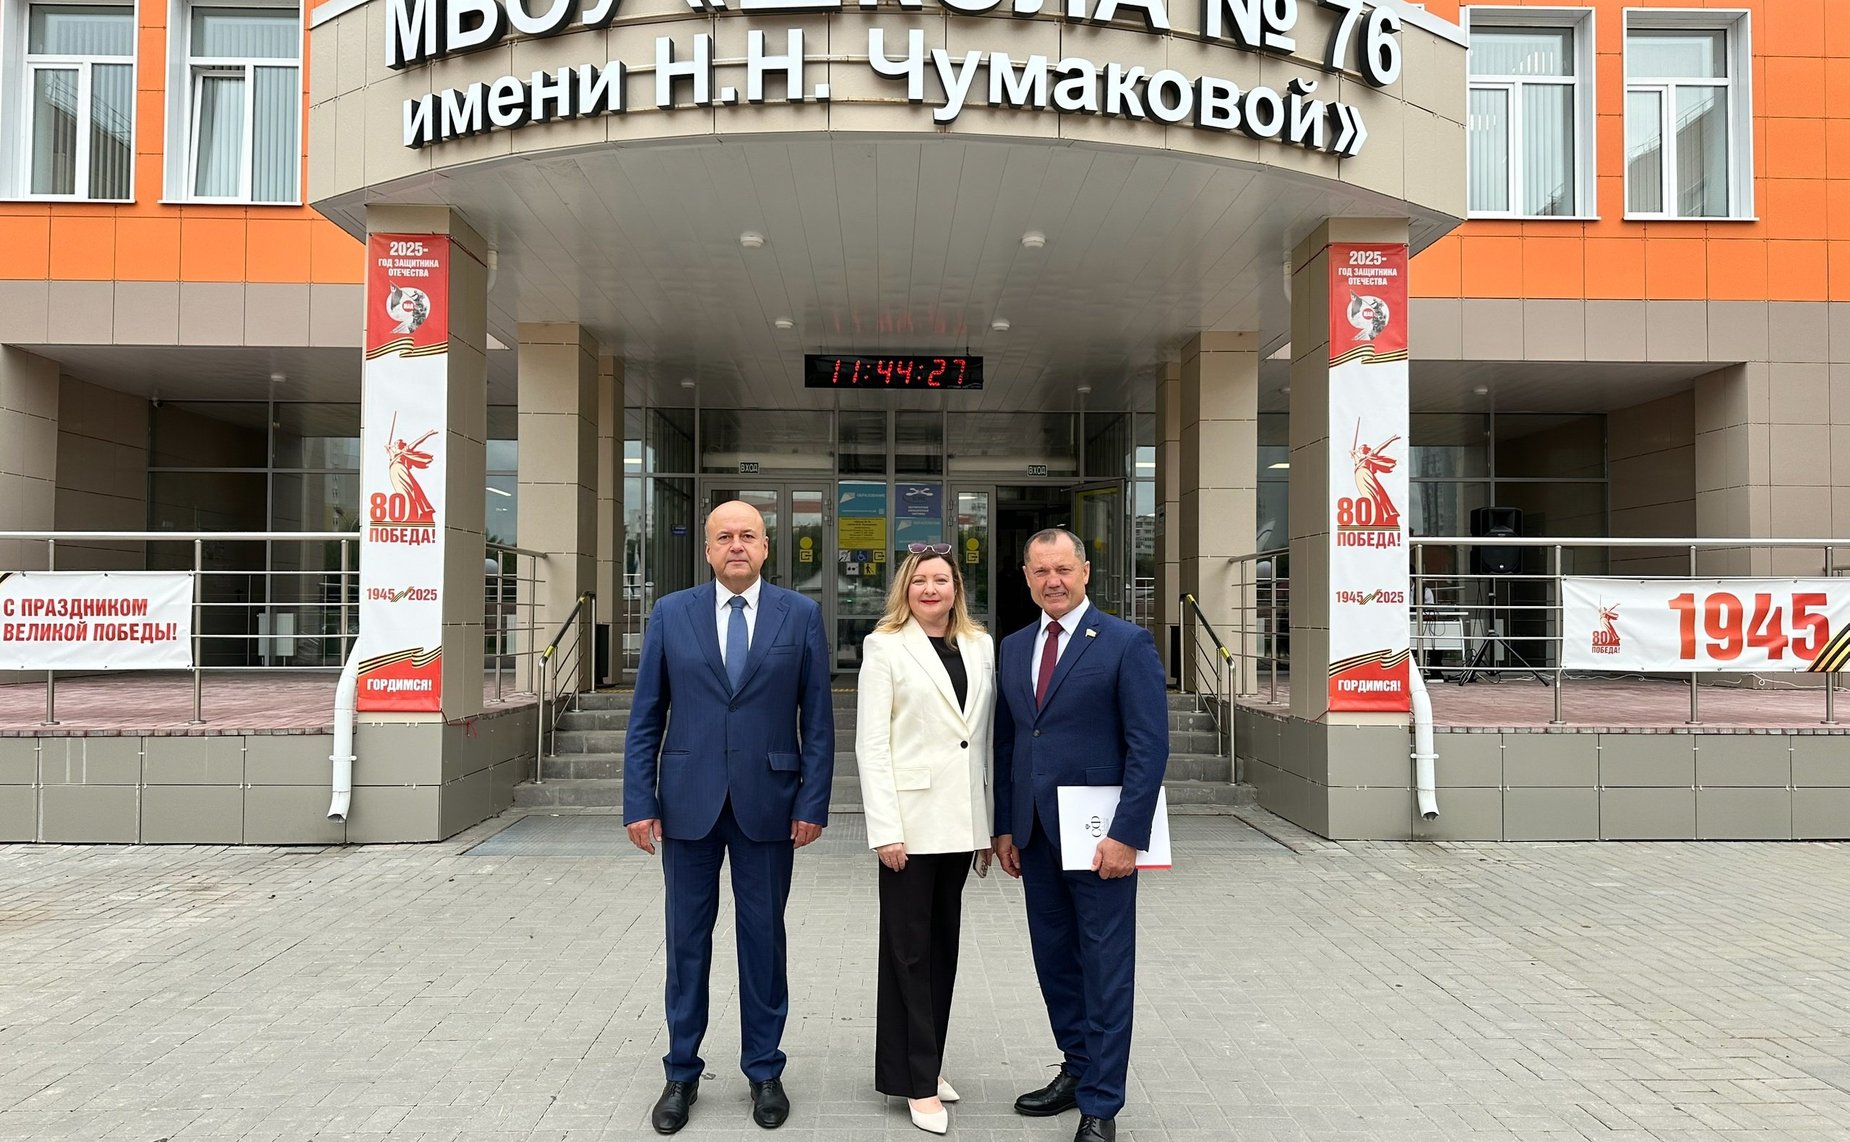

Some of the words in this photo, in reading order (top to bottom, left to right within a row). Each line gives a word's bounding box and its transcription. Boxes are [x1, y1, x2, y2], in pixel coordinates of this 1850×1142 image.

[1198, 0, 1298, 55] №
[1320, 0, 1402, 87] 76
[403, 60, 628, 149] имени
[656, 28, 831, 109] Н.Н.
[868, 28, 1368, 158] Чумаковой»
[389, 241, 429, 256] 2025-
[378, 258, 393, 267] ГОД
[394, 258, 439, 268] ЗАЩИТНИКА
[1349, 251, 1387, 265] 2025-
[388, 268, 429, 277] ОТЕЧЕСТВА
[1338, 267, 1352, 276] ГОД
[1353, 267, 1398, 277] ЗАЩИТНИКА
[1348, 277, 1388, 286] ОТЕЧЕСТВА
[832, 358, 966, 387] 11:44:27
[740, 463, 758, 472] ВХОД
[370, 491, 406, 522] 80
[1337, 497, 1372, 526] 80
[369, 527, 436, 546] ПОБЕДА!
[1337, 532, 1401, 549] ПОБЕДА!
[367, 587, 396, 600] 1945
[408, 588, 438, 601] 2025
[1336, 591, 1364, 603] 1945
[1376, 591, 1404, 604] 2025
[3, 598, 15, 617] С
[21, 598, 148, 619] ПРАЗДНИКОМ
[3, 621, 88, 641] ВЕЛИКОЙ
[93, 622, 177, 643] ПОБЕДЫ!
[1668, 592, 1830, 660] 1945
[1592, 630, 1608, 644] 80
[1592, 646, 1620, 654] ПОБЕДА!
[366, 678, 432, 692] ГОРДИМСЯ!
[1337, 679, 1401, 693] ГОРДИМСЯ!
